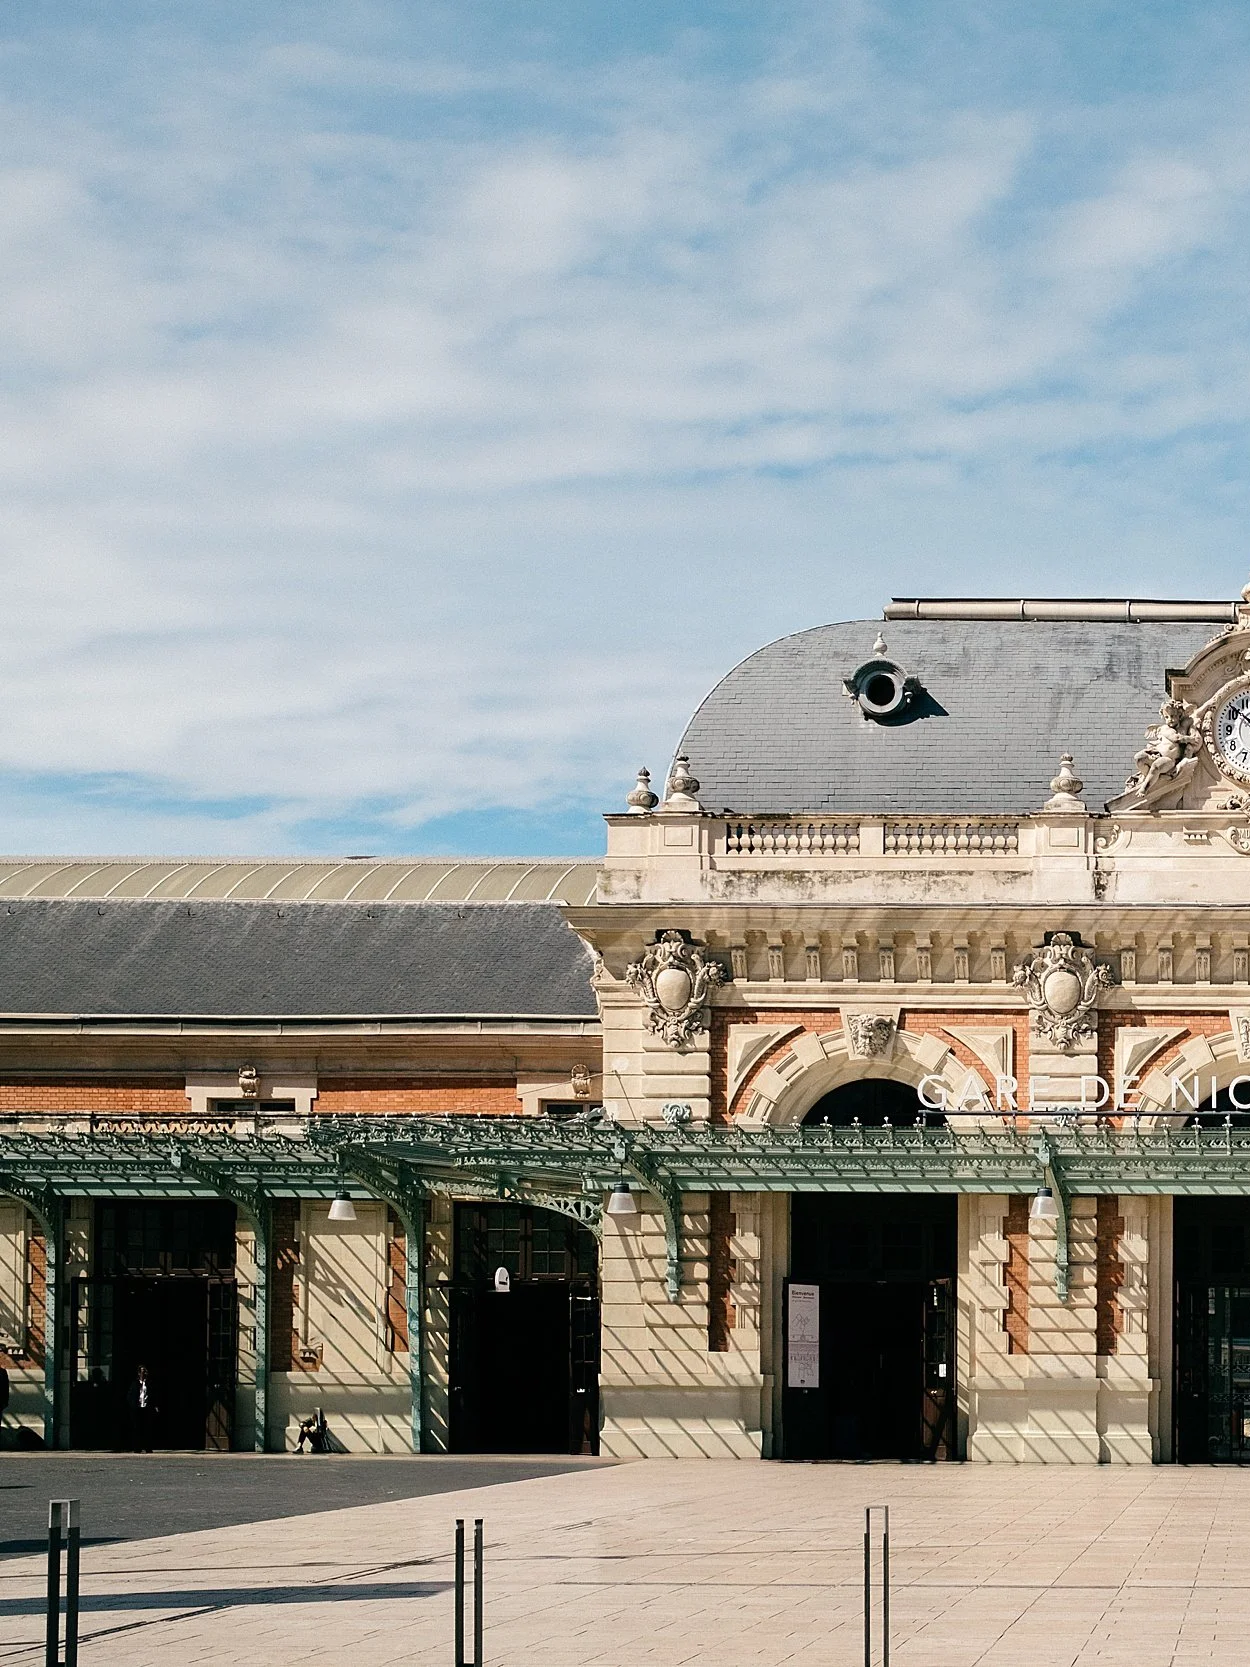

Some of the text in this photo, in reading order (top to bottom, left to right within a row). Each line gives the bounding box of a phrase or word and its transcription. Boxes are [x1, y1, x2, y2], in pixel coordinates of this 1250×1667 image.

[1241, 699, 1248, 709] 11
[1229, 709, 1238, 720] 10
[1226, 725, 1232, 735] 9
[1230, 740, 1236, 751] 8
[1242, 752, 1248, 763] 7
[917, 1074, 1051, 1109] GARE
[1081, 1075, 1141, 1109] DE
